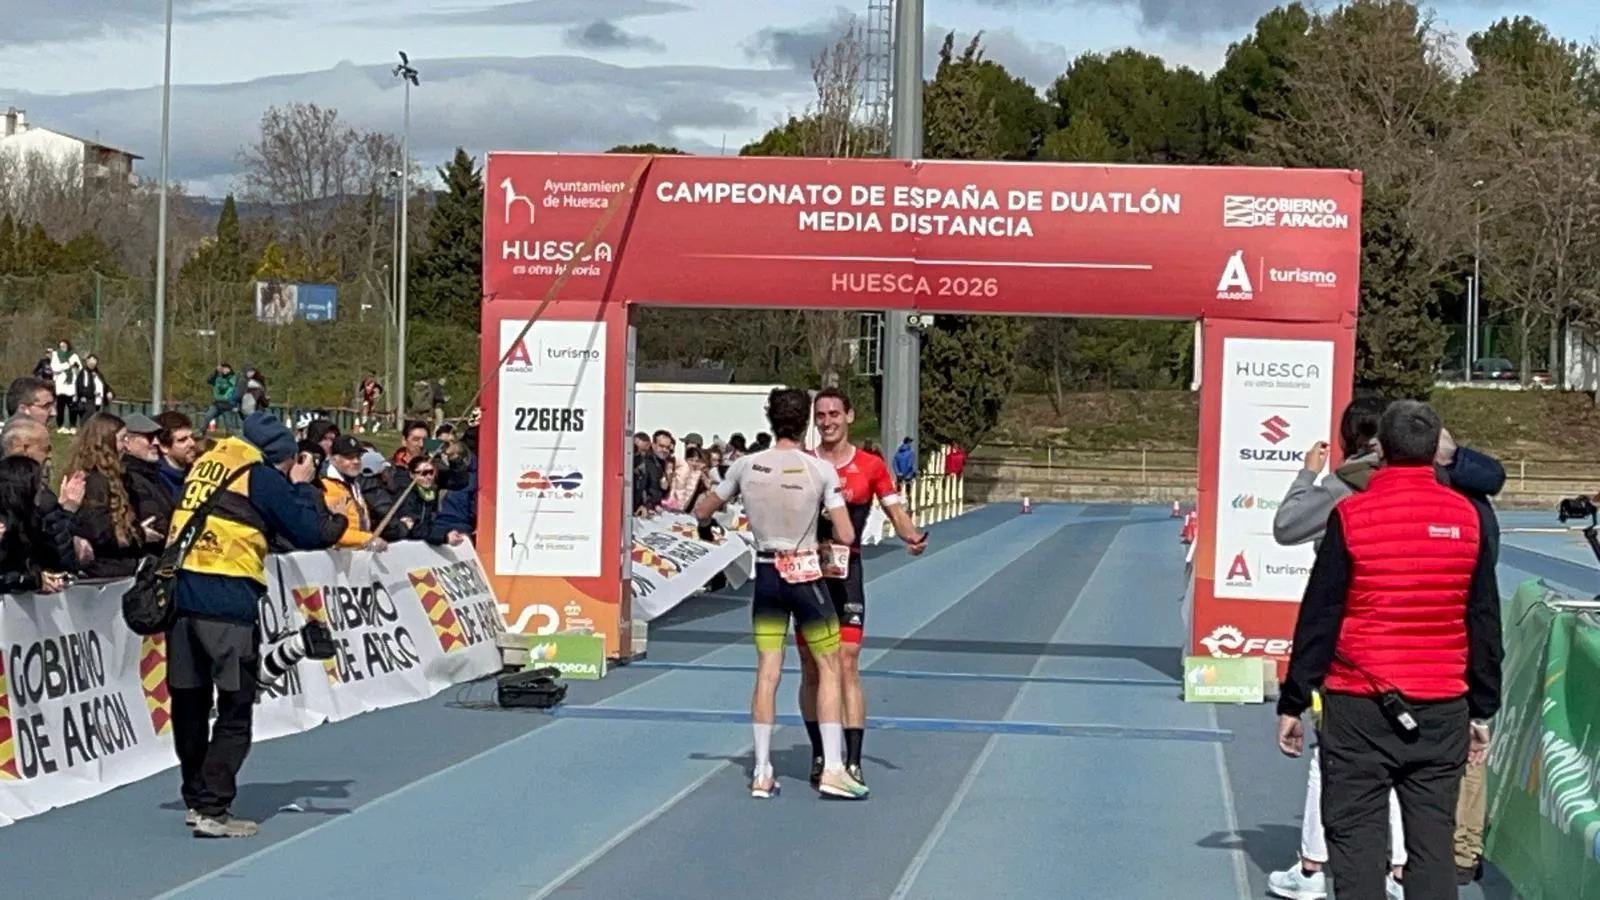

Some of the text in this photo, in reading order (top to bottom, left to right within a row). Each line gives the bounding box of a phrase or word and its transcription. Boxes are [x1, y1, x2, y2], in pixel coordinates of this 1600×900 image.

[544, 179, 633, 194] Ayuntamient
[543, 195, 609, 209] de Huesca
[656, 182, 1181, 215] CAMPEONATO DE ESPAÑA DE DUATLÓN
[1254, 197, 1337, 215] GOBIERNO
[799, 211, 1034, 238] MEDIA DISTANCIA
[1254, 211, 1348, 229] DE ARAGON
[528, 264, 552, 275] otra
[554, 264, 600, 277] hitoria
[1269, 267, 1337, 284] turismo
[831, 273, 999, 297] HUESCA 2026
[547, 346, 600, 359] turismo
[1236, 361, 1320, 379] HUESCA
[514, 407, 584, 432] 226ERS
[1239, 448, 1304, 462] SUZUK
[16, 712, 59, 779] DE
